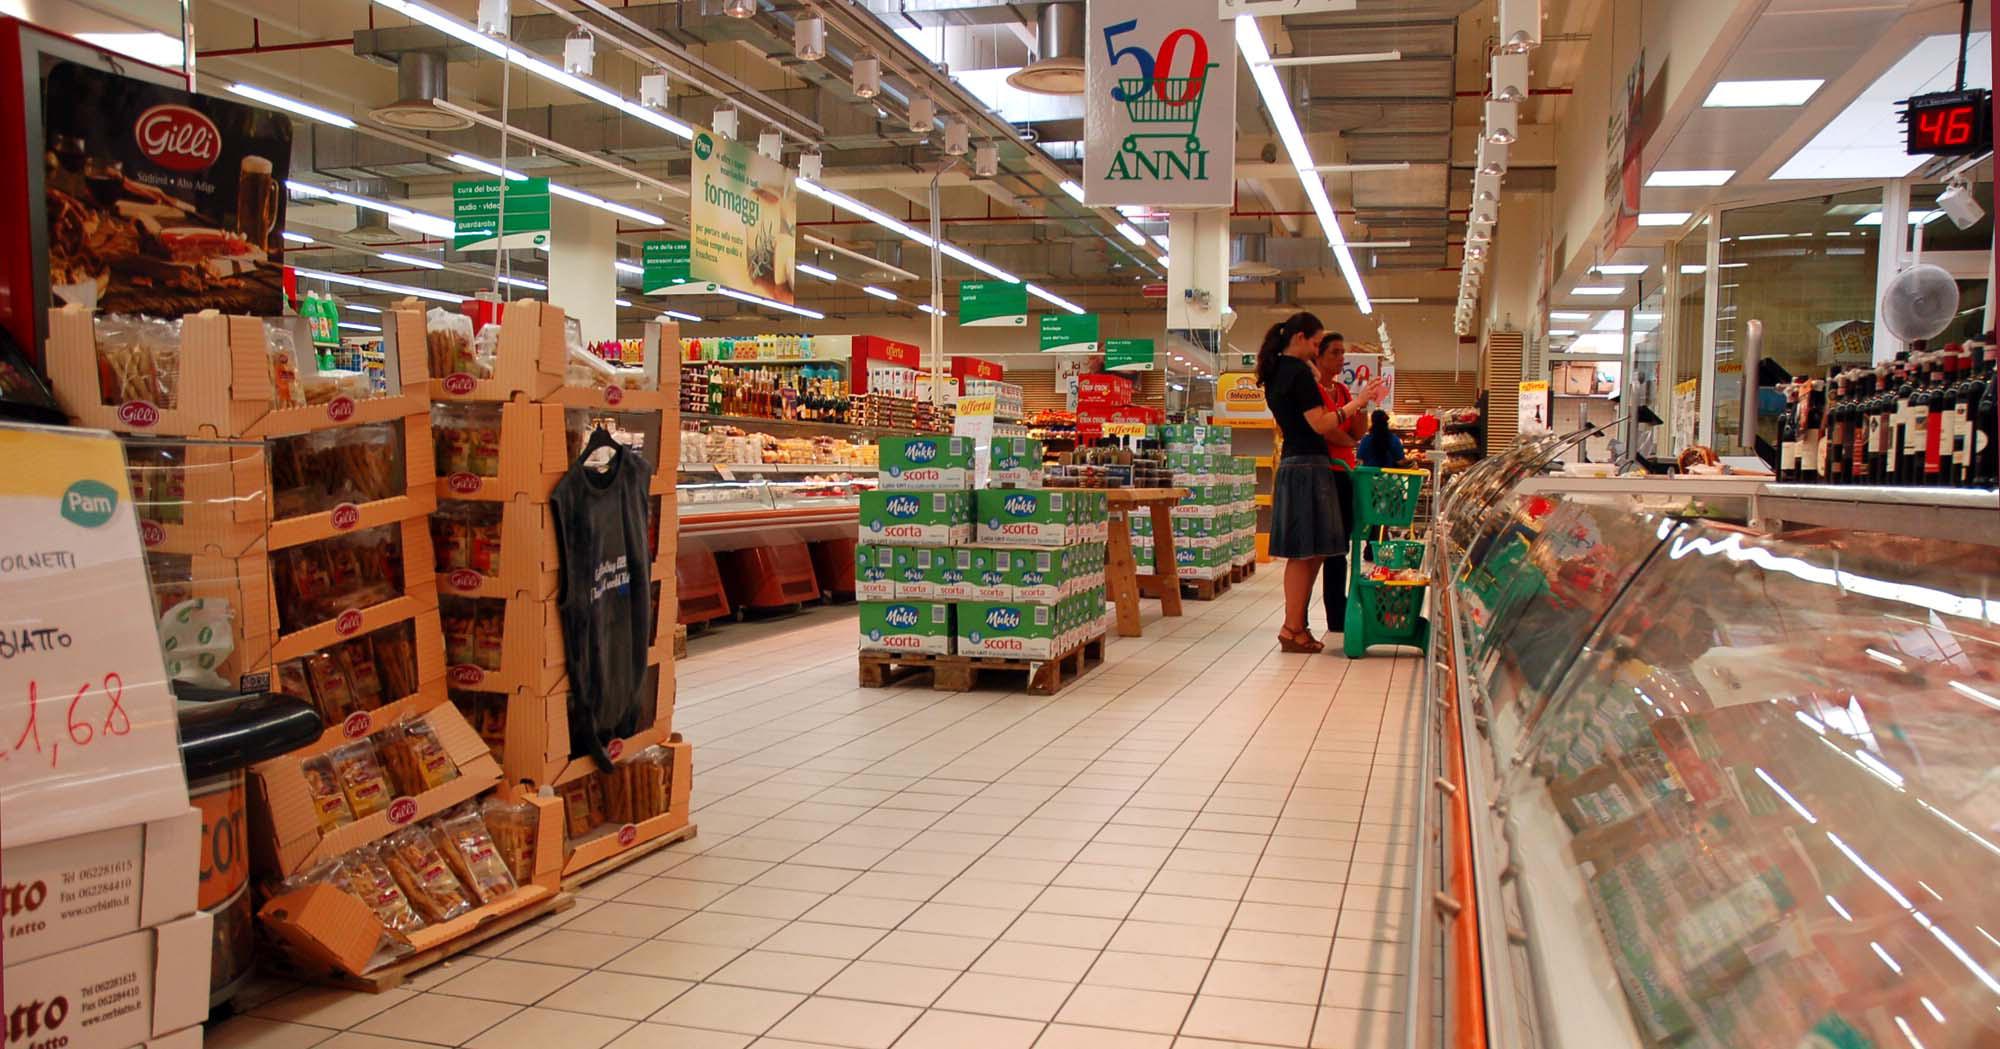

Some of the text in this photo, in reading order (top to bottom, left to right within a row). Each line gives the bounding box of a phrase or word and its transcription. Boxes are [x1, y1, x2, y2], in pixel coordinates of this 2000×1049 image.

[1103, 19, 1209, 107] 50
[1918, 106, 1974, 146] 46
[144, 115, 213, 158] Gilli
[1104, 150, 1210, 181] ANNI
[704, 173, 760, 227] formaggi
[447, 376, 473, 391] Gilli
[122, 405, 155, 424] Gilli
[329, 401, 352, 418] Gilli
[960, 400, 993, 415] offerta
[1108, 425, 1142, 434] offerta
[904, 443, 936, 459] Mukki
[903, 469, 940, 481] scorta
[451, 477, 479, 491] Gilli
[67, 491, 112, 515] Pam
[886, 499, 919, 515] Mukki
[1004, 498, 1037, 514] Mukki
[333, 508, 357, 526] Gilli
[885, 525, 922, 538] scorta
[1002, 523, 1039, 535] scorta
[863, 583, 887, 593] scorta
[902, 584, 927, 593] scorta
[940, 586, 965, 595] scorta
[979, 587, 1005, 597] scorta
[1020, 588, 1046, 597] scorta
[338, 613, 361, 632] Gilli
[886, 608, 918, 624] Mukki
[986, 610, 1020, 627] Mukki
[883, 636, 921, 648] scorta
[984, 638, 1023, 650] scorta
[345, 717, 369, 735] Gilli
[390, 802, 416, 821] Gilli
